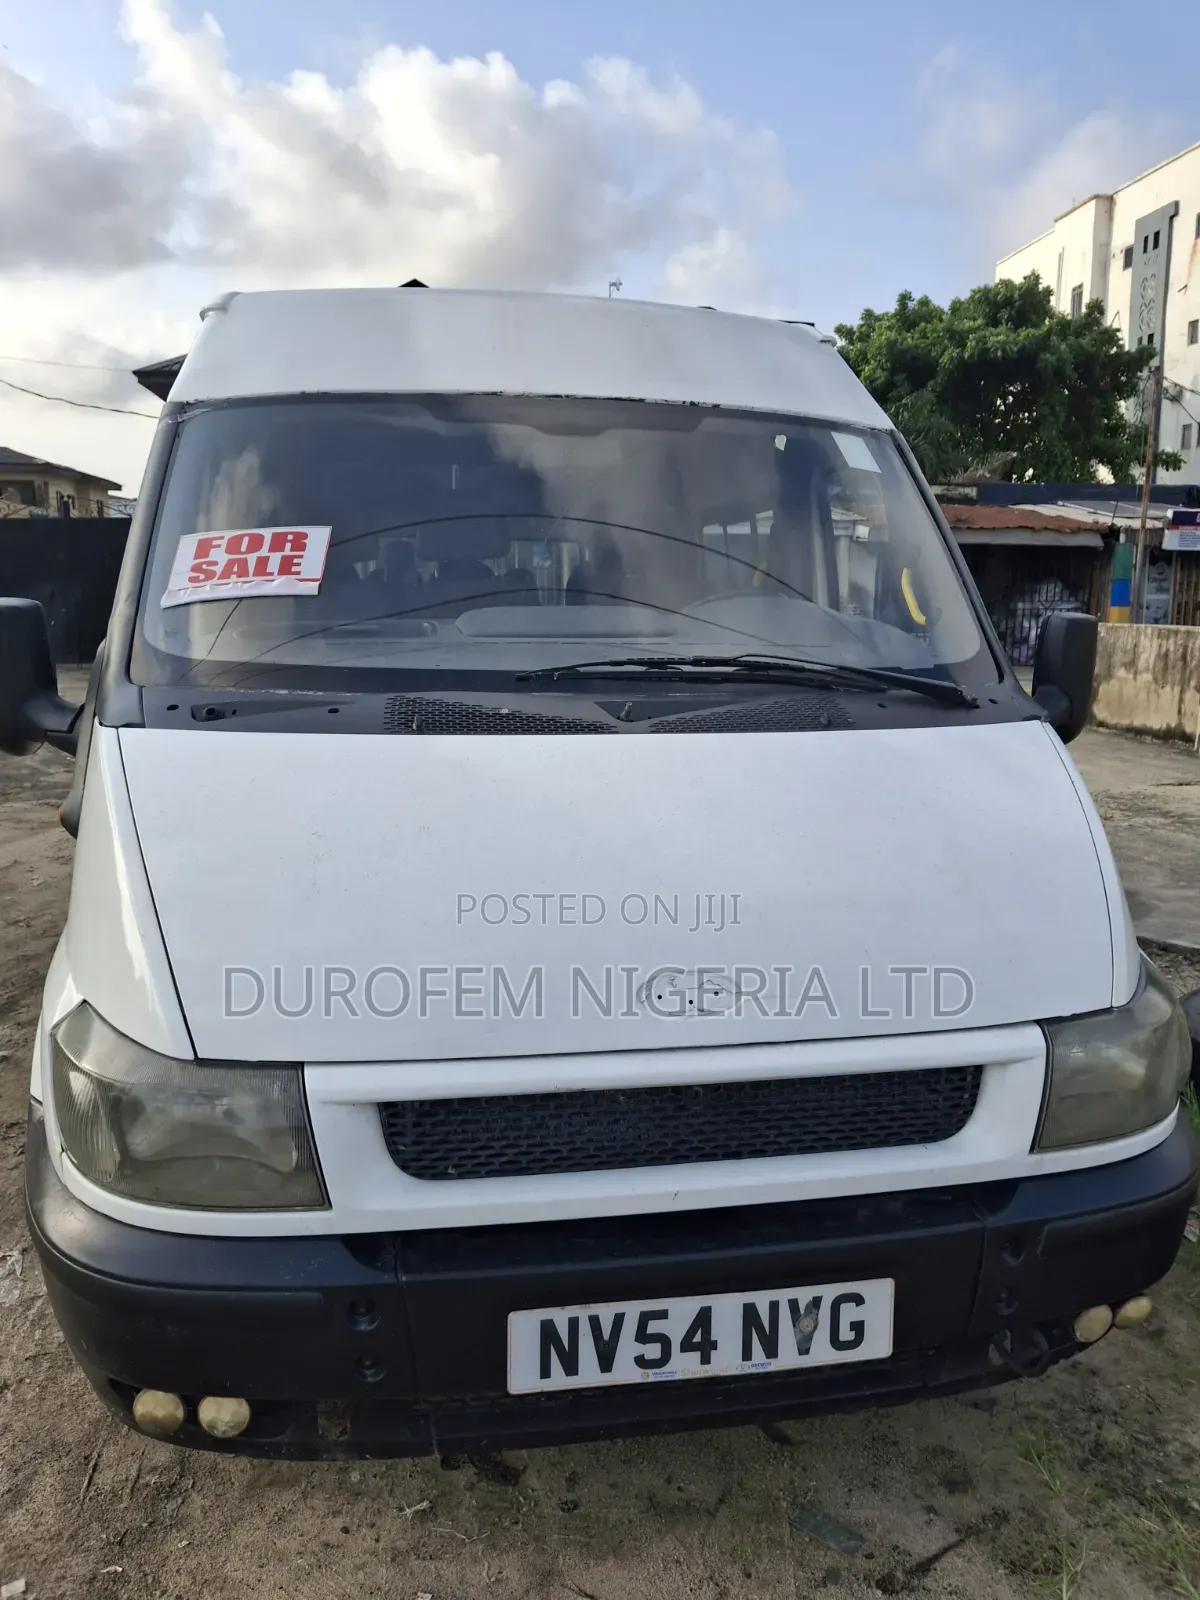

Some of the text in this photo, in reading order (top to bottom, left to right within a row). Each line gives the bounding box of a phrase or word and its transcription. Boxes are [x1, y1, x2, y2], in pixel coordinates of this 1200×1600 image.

[193, 531, 309, 561] FOR
[188, 555, 304, 584] SALE
[540, 1292, 866, 1380] NV54 NVG
